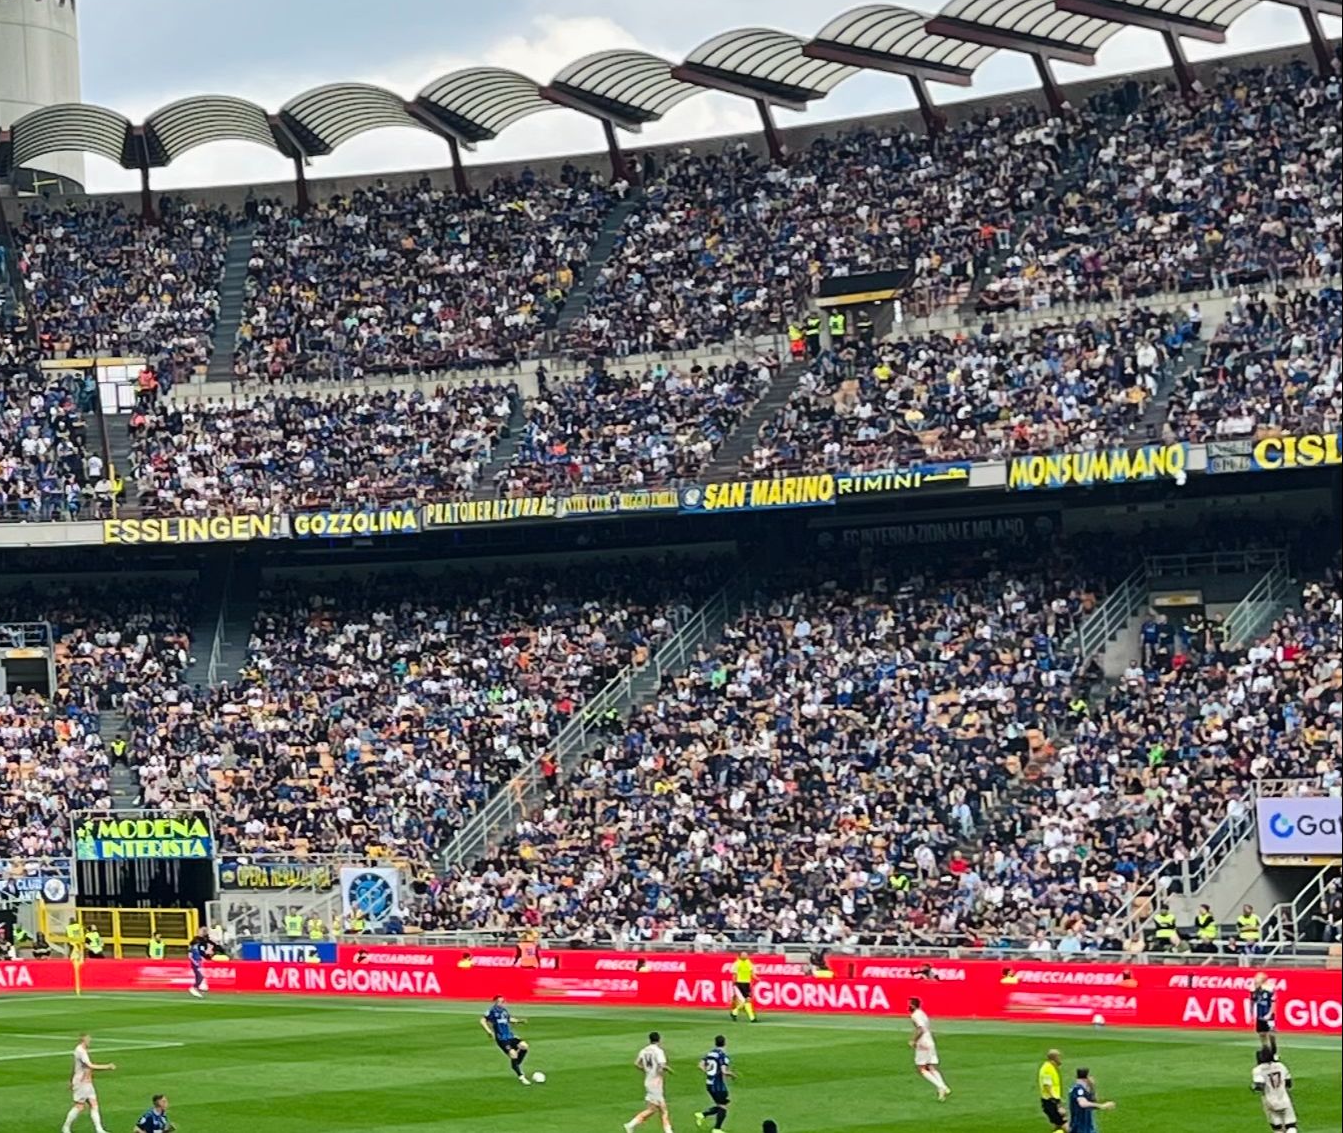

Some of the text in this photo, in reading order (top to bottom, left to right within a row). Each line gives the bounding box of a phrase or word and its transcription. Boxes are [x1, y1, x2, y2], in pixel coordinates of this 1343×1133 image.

[1009, 443, 1185, 489] MONSUMMANO
[703, 474, 834, 510] SAN MARINO
[838, 473, 921, 494] RIMINI
[104, 514, 272, 543] ESSLINGEN
[294, 509, 417, 536] GOZZOLINA
[98, 819, 209, 839] MODENA
[102, 839, 207, 858] INTERISTA
[265, 968, 441, 995] A/R IN GIORNATA
[672, 978, 716, 1003] A/R
[754, 979, 890, 1009] GIORNATA
[1183, 997, 1237, 1024] A/R
